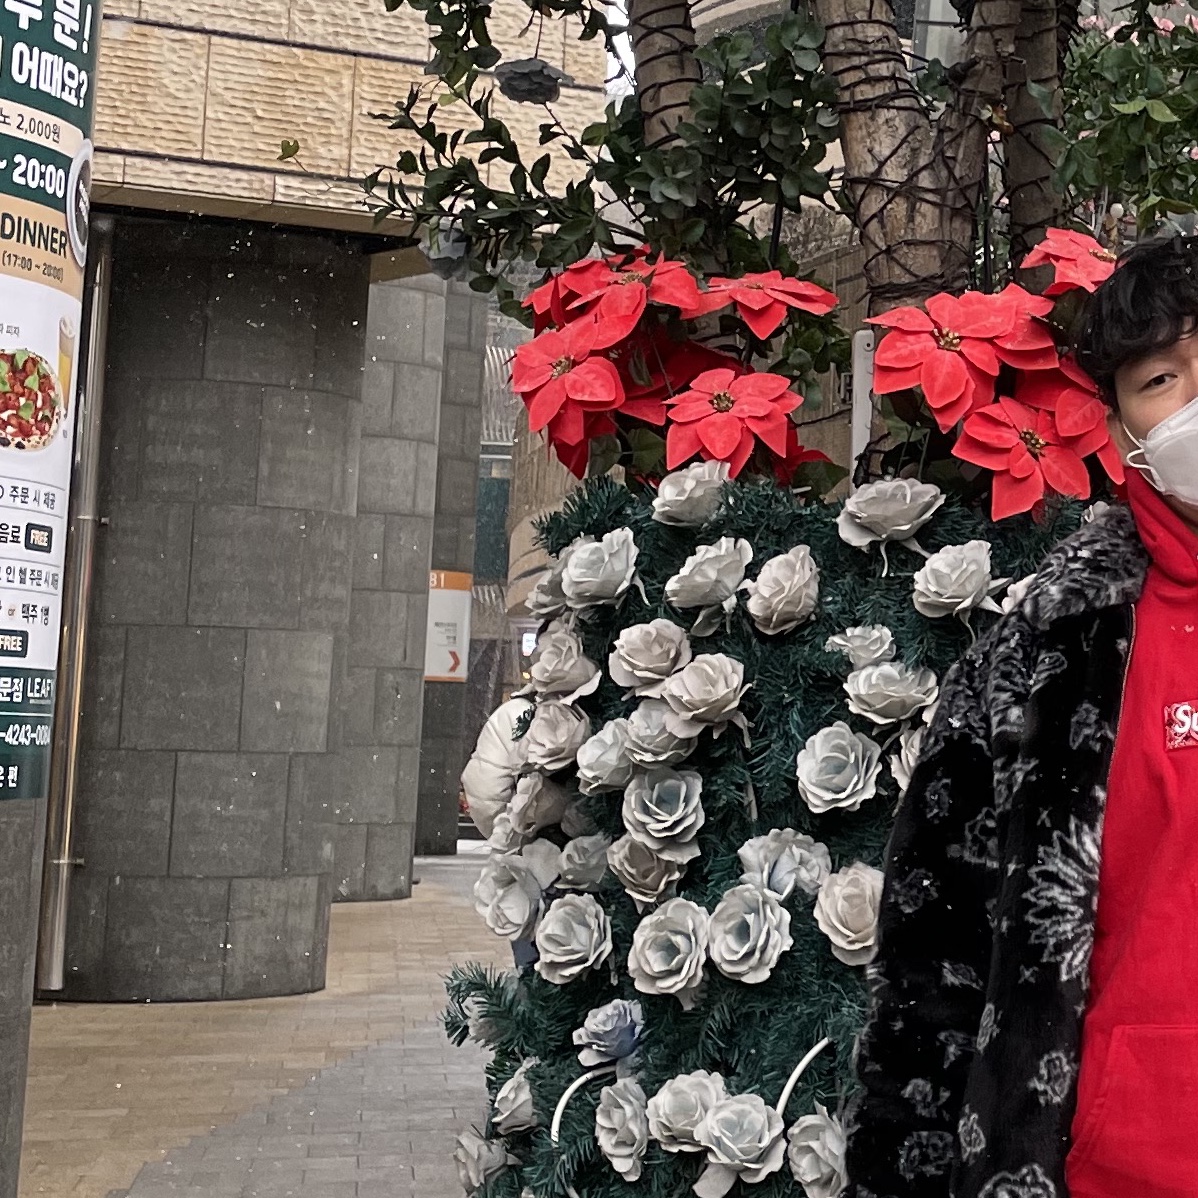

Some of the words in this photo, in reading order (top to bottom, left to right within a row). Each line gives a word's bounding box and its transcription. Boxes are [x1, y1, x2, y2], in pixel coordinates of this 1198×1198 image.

[11, 41, 88, 109] 어때요?
[16, 113, 61, 144] 2,000원
[12, 153, 66, 199] 20:00
[0, 212, 68, 260] DINNER
[9, 485, 30, 504] 주문
[32, 488, 41, 507] 시
[30, 528, 49, 547] FREE
[429, 571, 445, 588] B1
